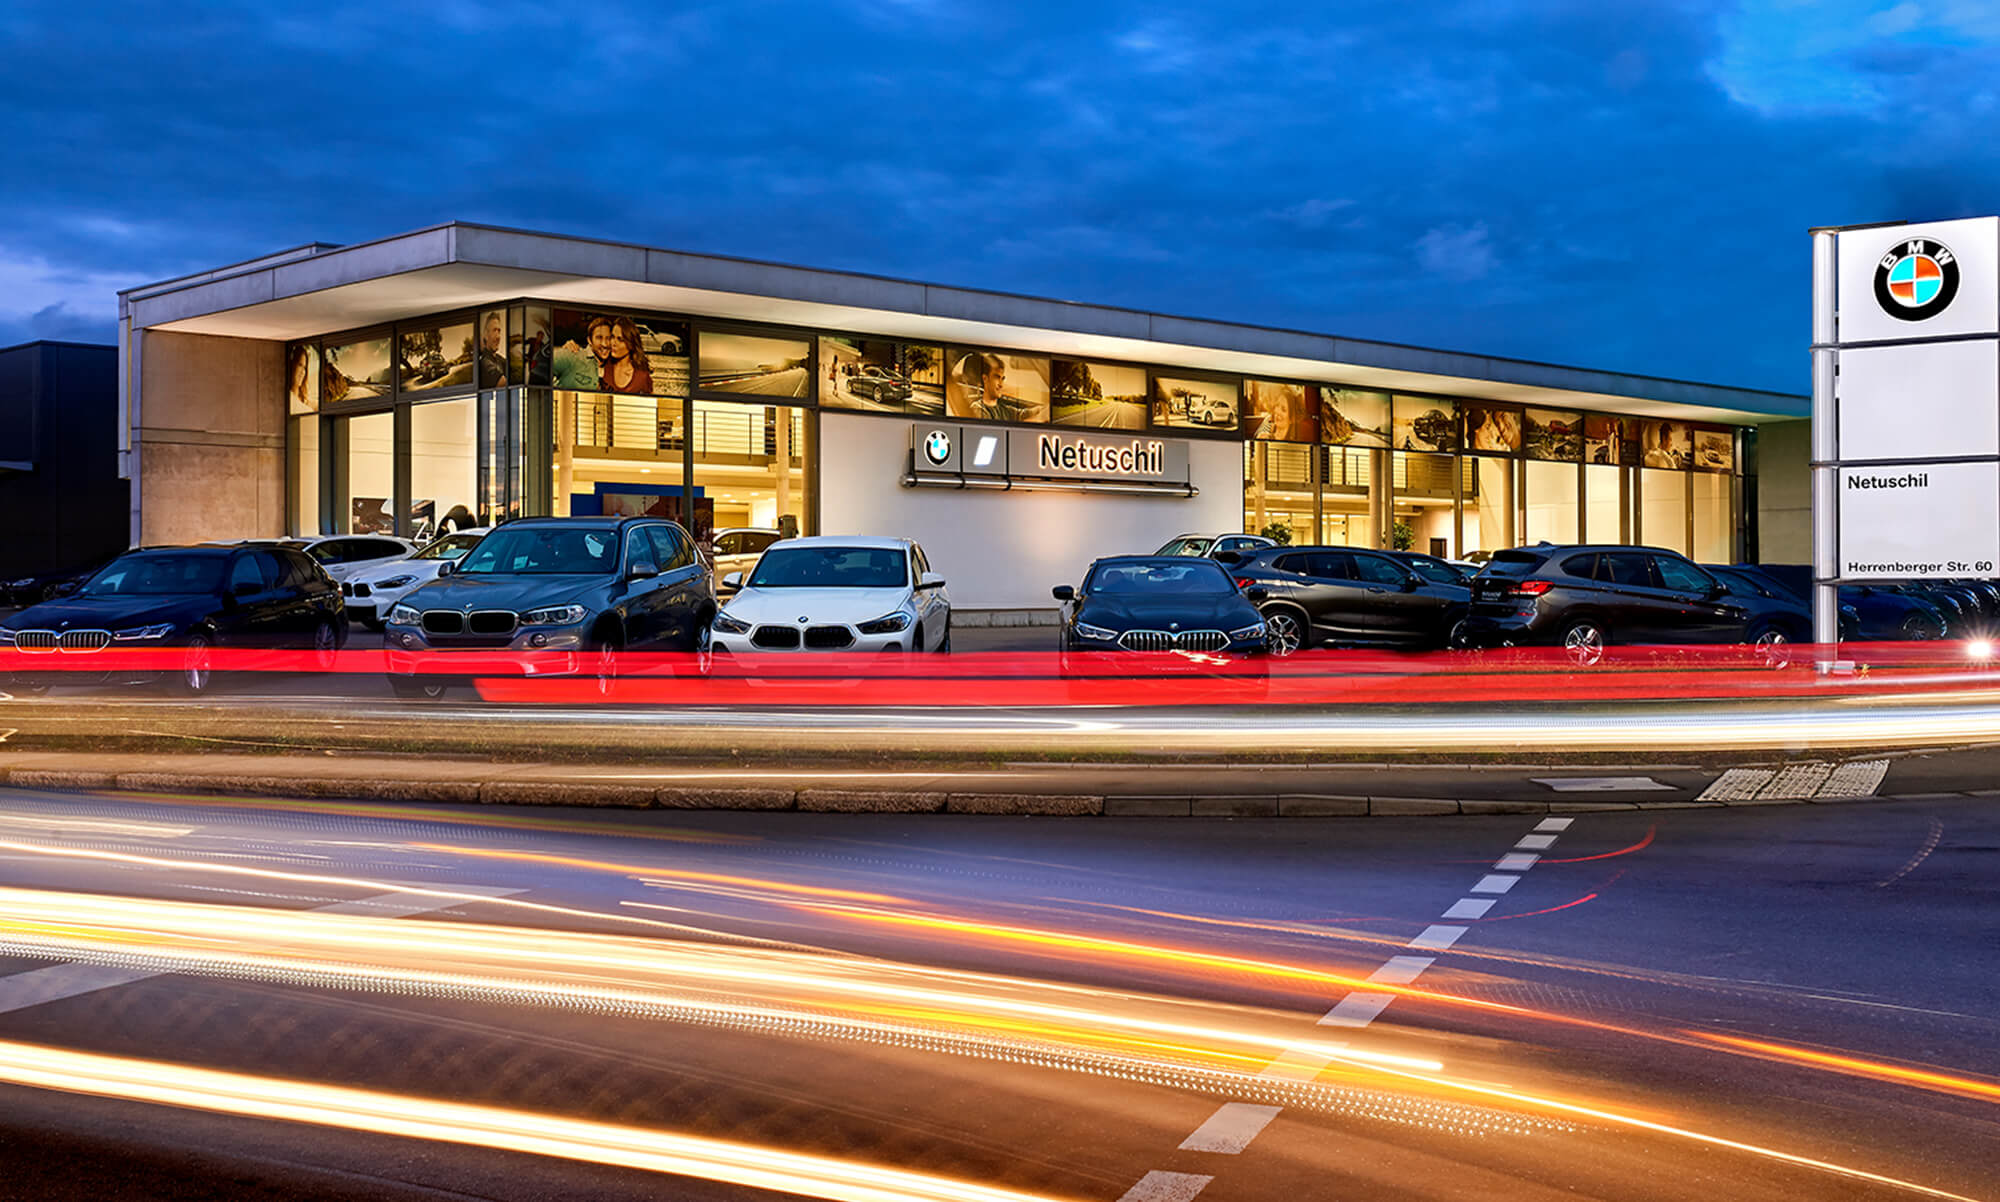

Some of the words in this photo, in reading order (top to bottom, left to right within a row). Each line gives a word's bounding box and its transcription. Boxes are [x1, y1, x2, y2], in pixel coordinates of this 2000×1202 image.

[1880, 240, 1953, 270] BMW
[1040, 435, 1164, 473] Netuschil
[1848, 473, 1928, 489] Netuschil
[1848, 562, 1942, 574] Herrenberger
[1946, 561, 1971, 572] Str.
[1975, 560, 1993, 572] 60
